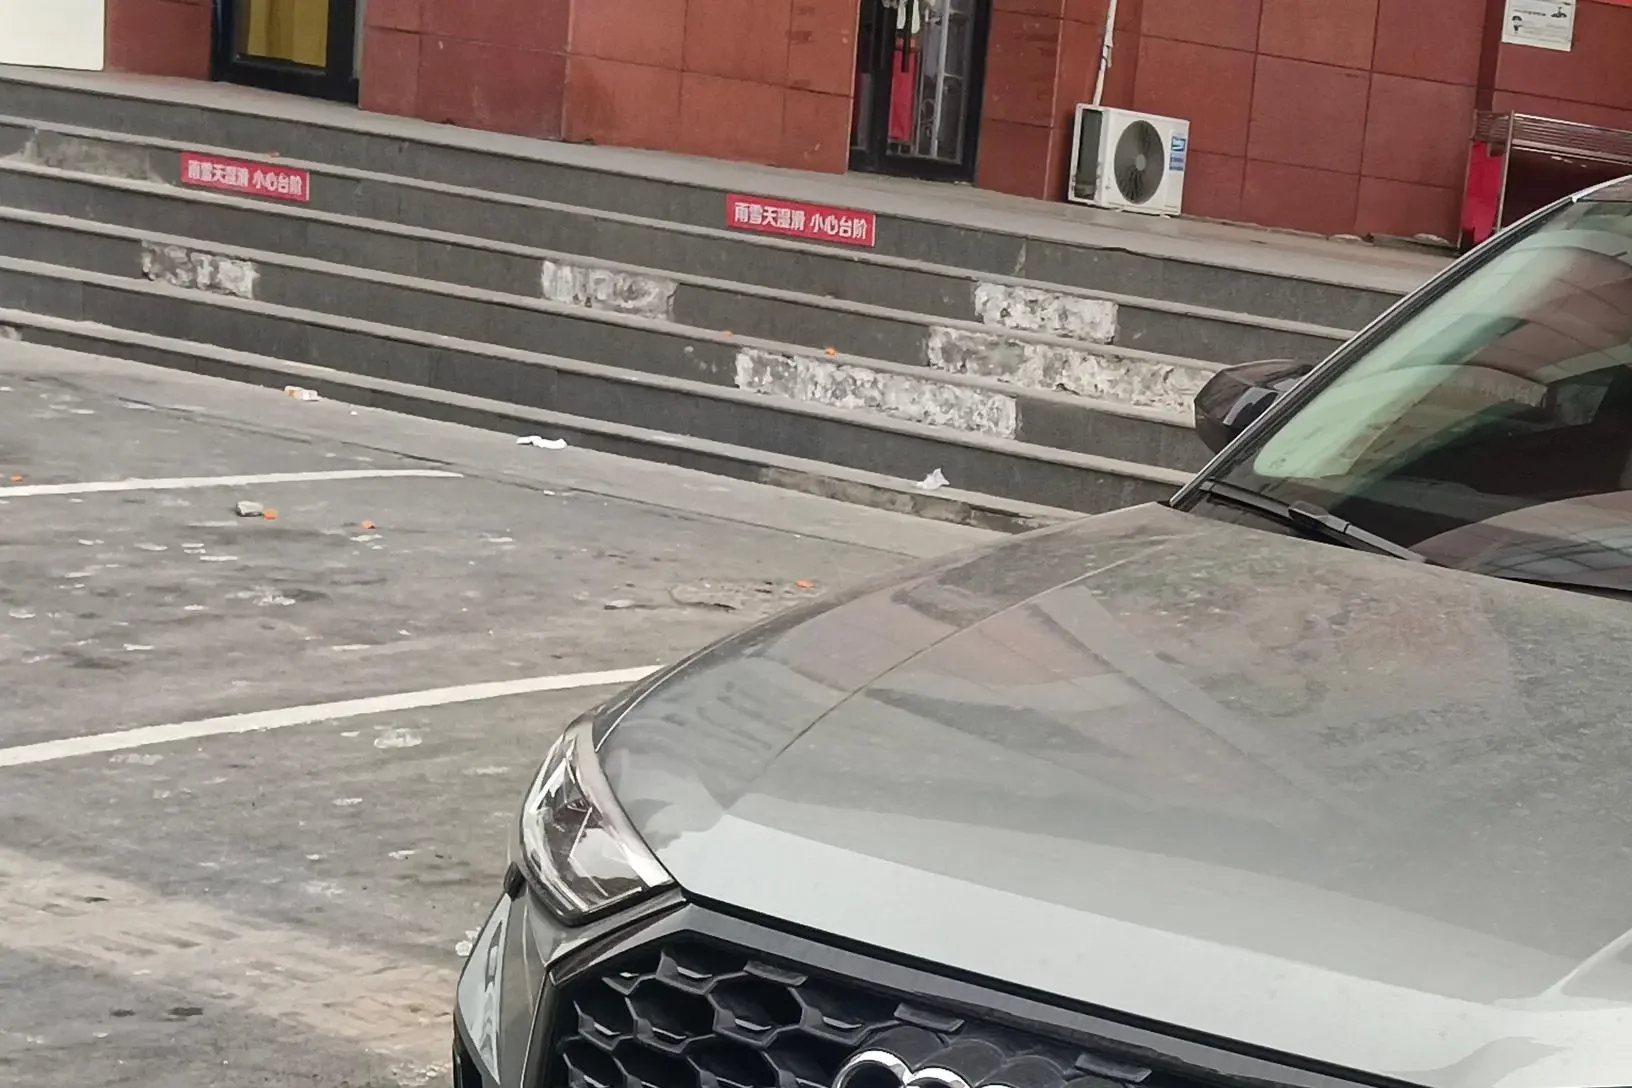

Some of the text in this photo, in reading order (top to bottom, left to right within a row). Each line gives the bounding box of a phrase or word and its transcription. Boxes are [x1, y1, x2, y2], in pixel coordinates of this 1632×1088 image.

[252, 169, 302, 195] 小心台阶
[734, 202, 868, 239] 雨雪天湿滑 小心台阶
